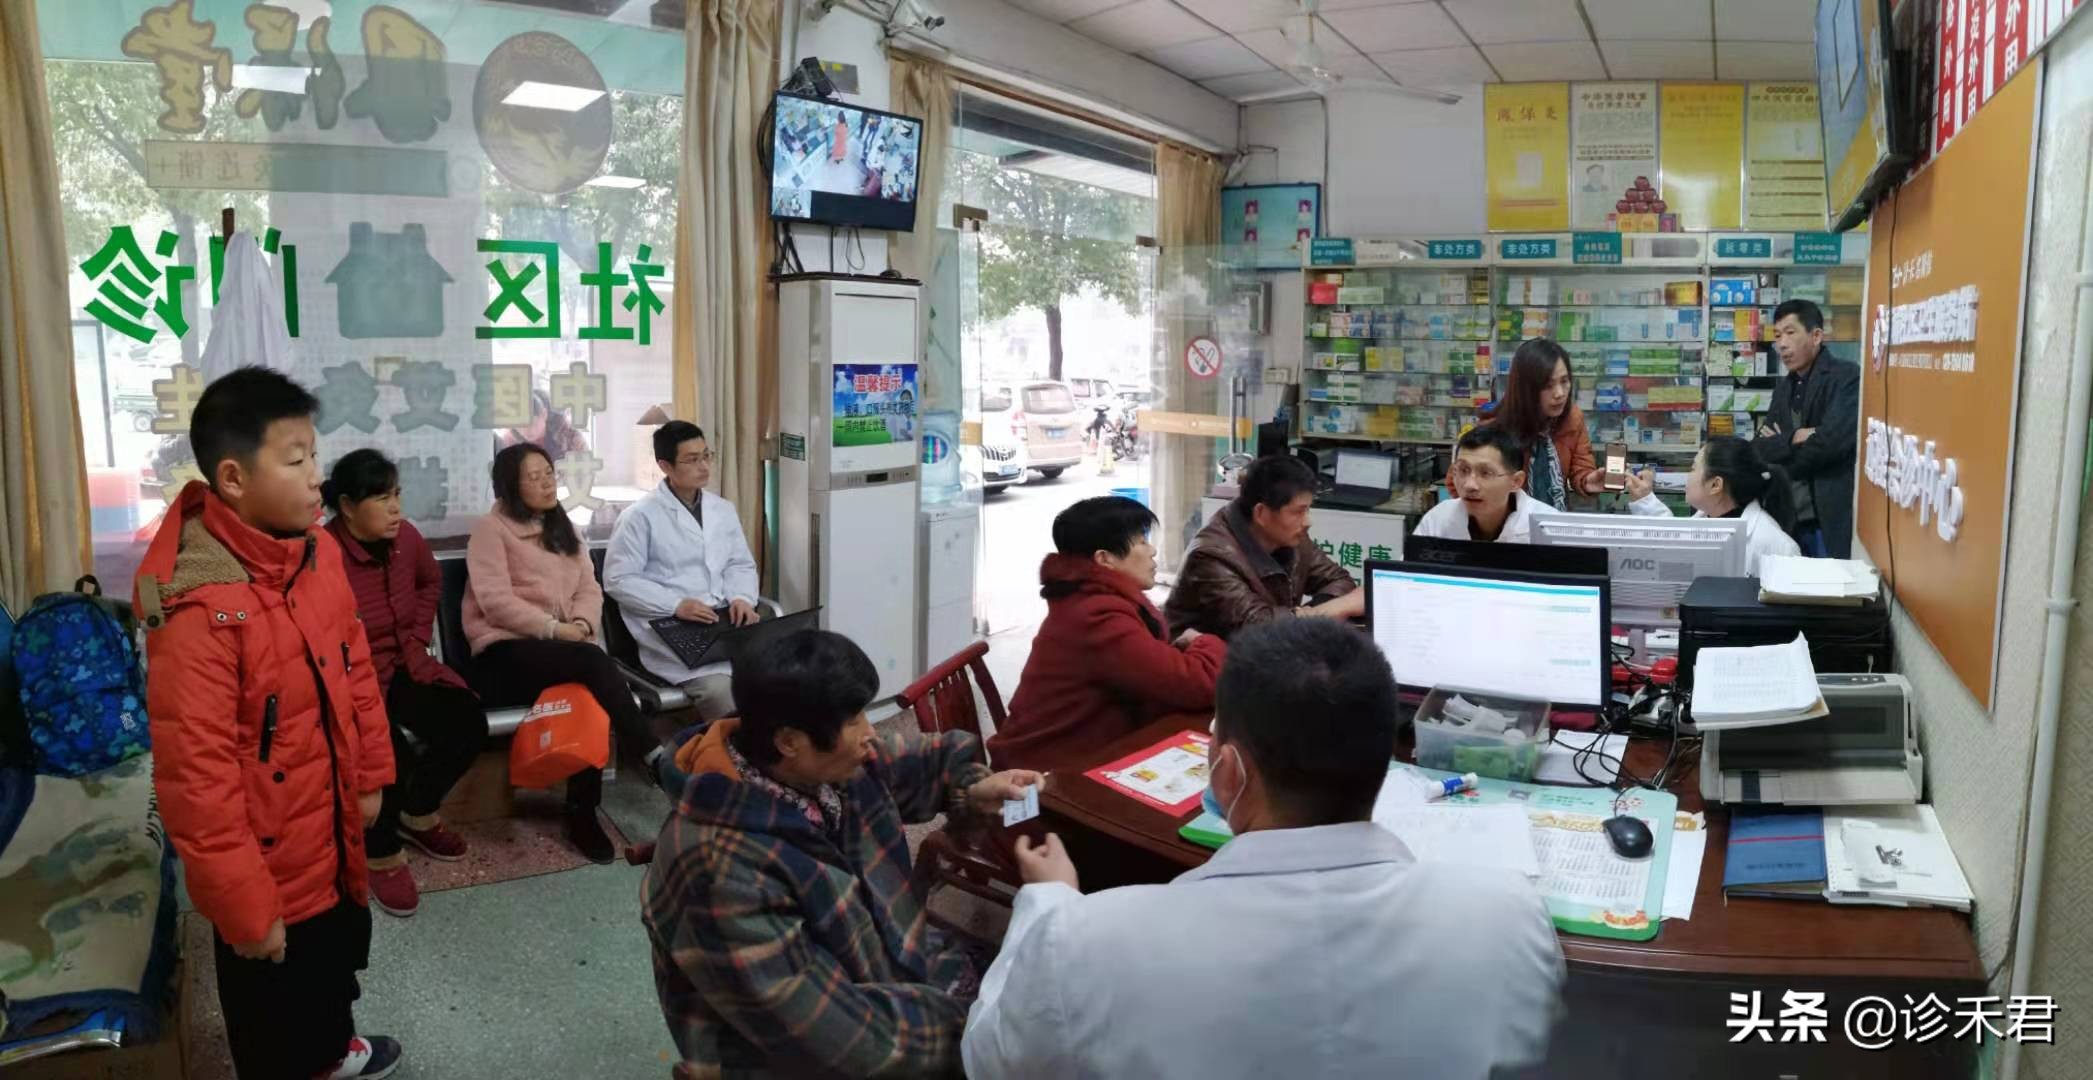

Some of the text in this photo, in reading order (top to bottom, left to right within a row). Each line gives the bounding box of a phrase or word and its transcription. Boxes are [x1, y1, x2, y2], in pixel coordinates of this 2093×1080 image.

[854, 374, 904, 393] 温馨提示
[1419, 550, 1457, 562] acer
[1620, 558, 1656, 571] AOC
